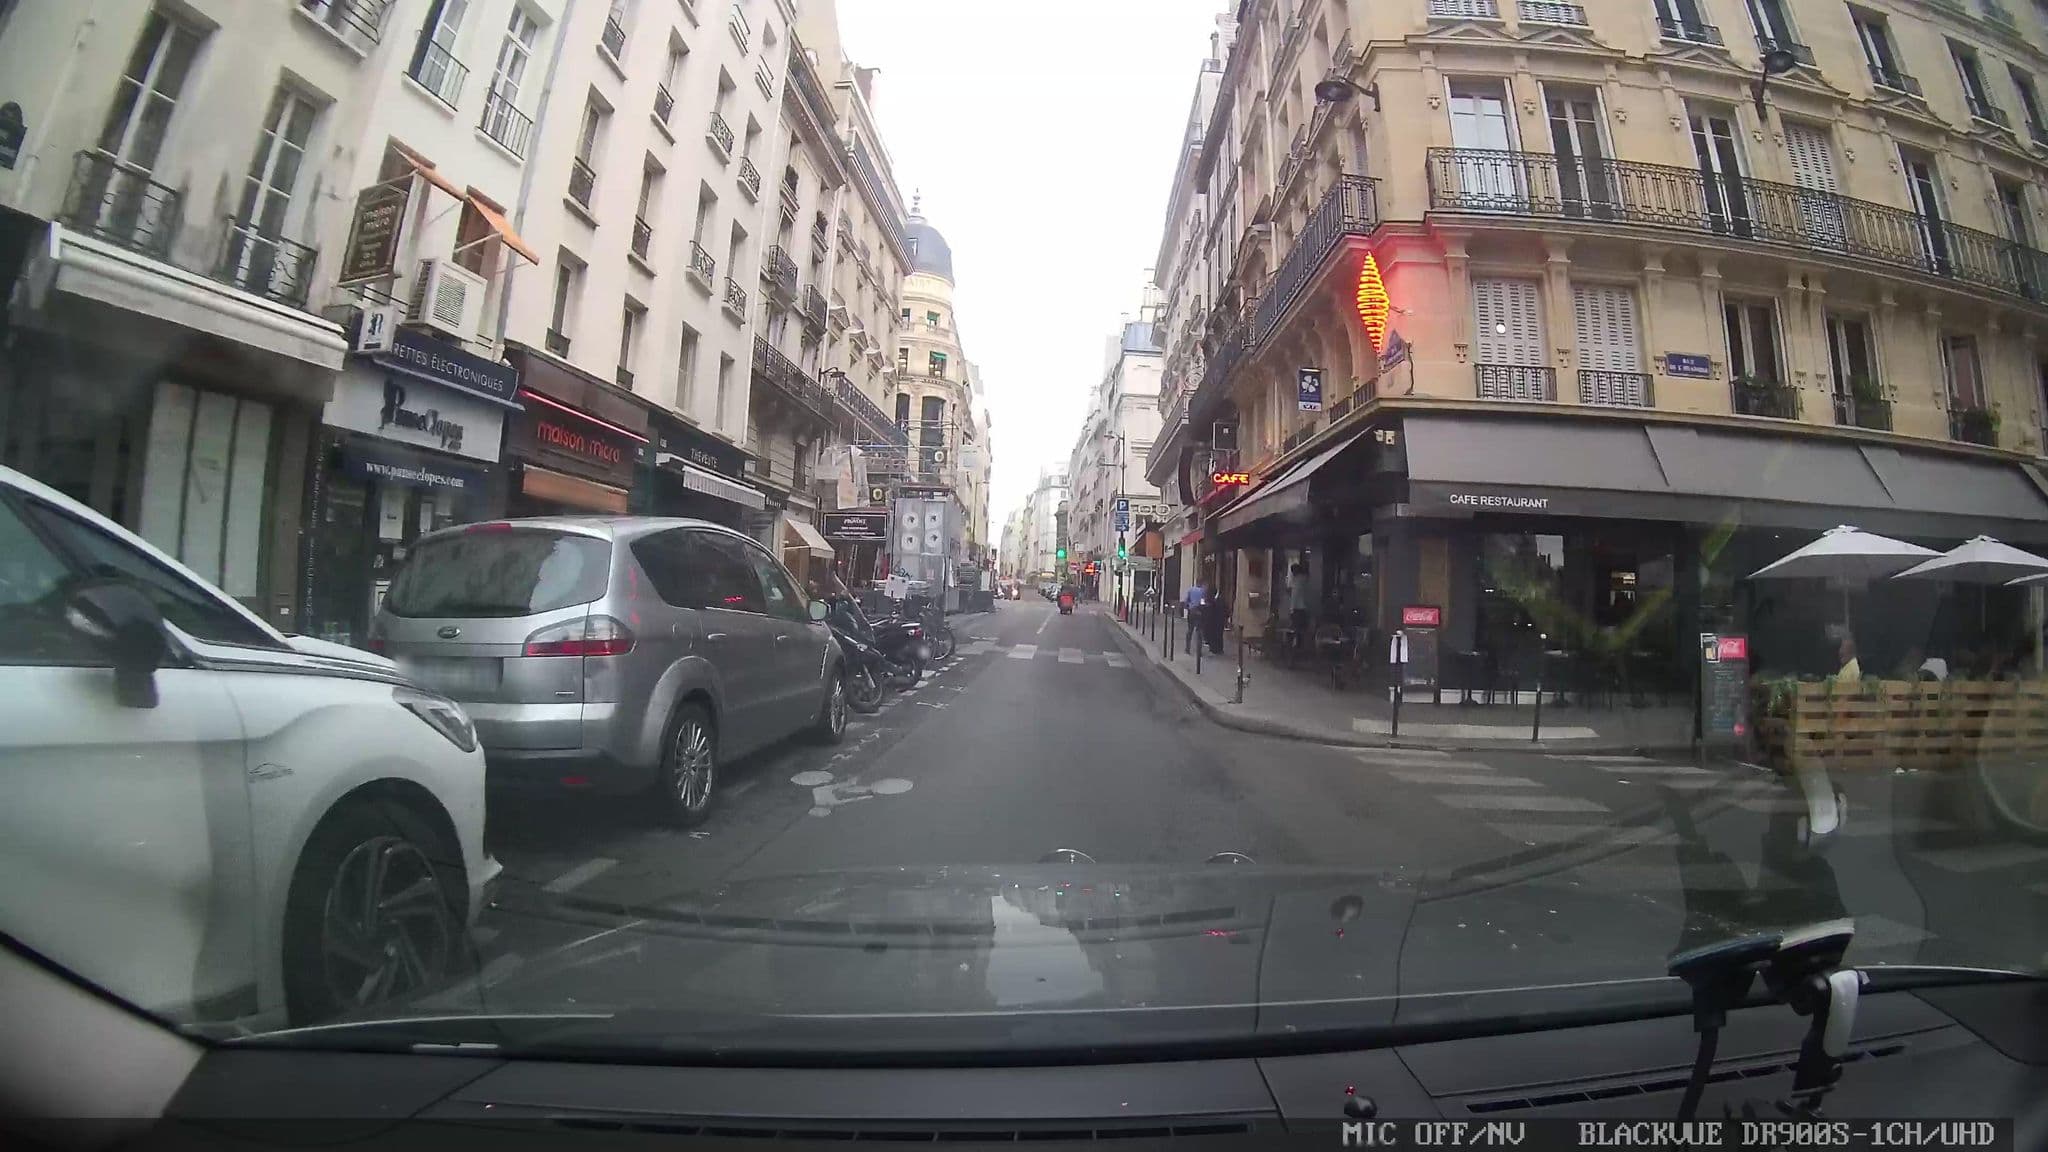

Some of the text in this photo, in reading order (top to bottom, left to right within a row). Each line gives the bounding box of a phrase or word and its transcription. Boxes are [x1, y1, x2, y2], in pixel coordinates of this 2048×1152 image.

[431, 352, 504, 392] ÉLECTRONIQUES
[537, 421, 620, 463] maison micro
[1449, 494, 1549, 508] CAFE RESTAURANT
